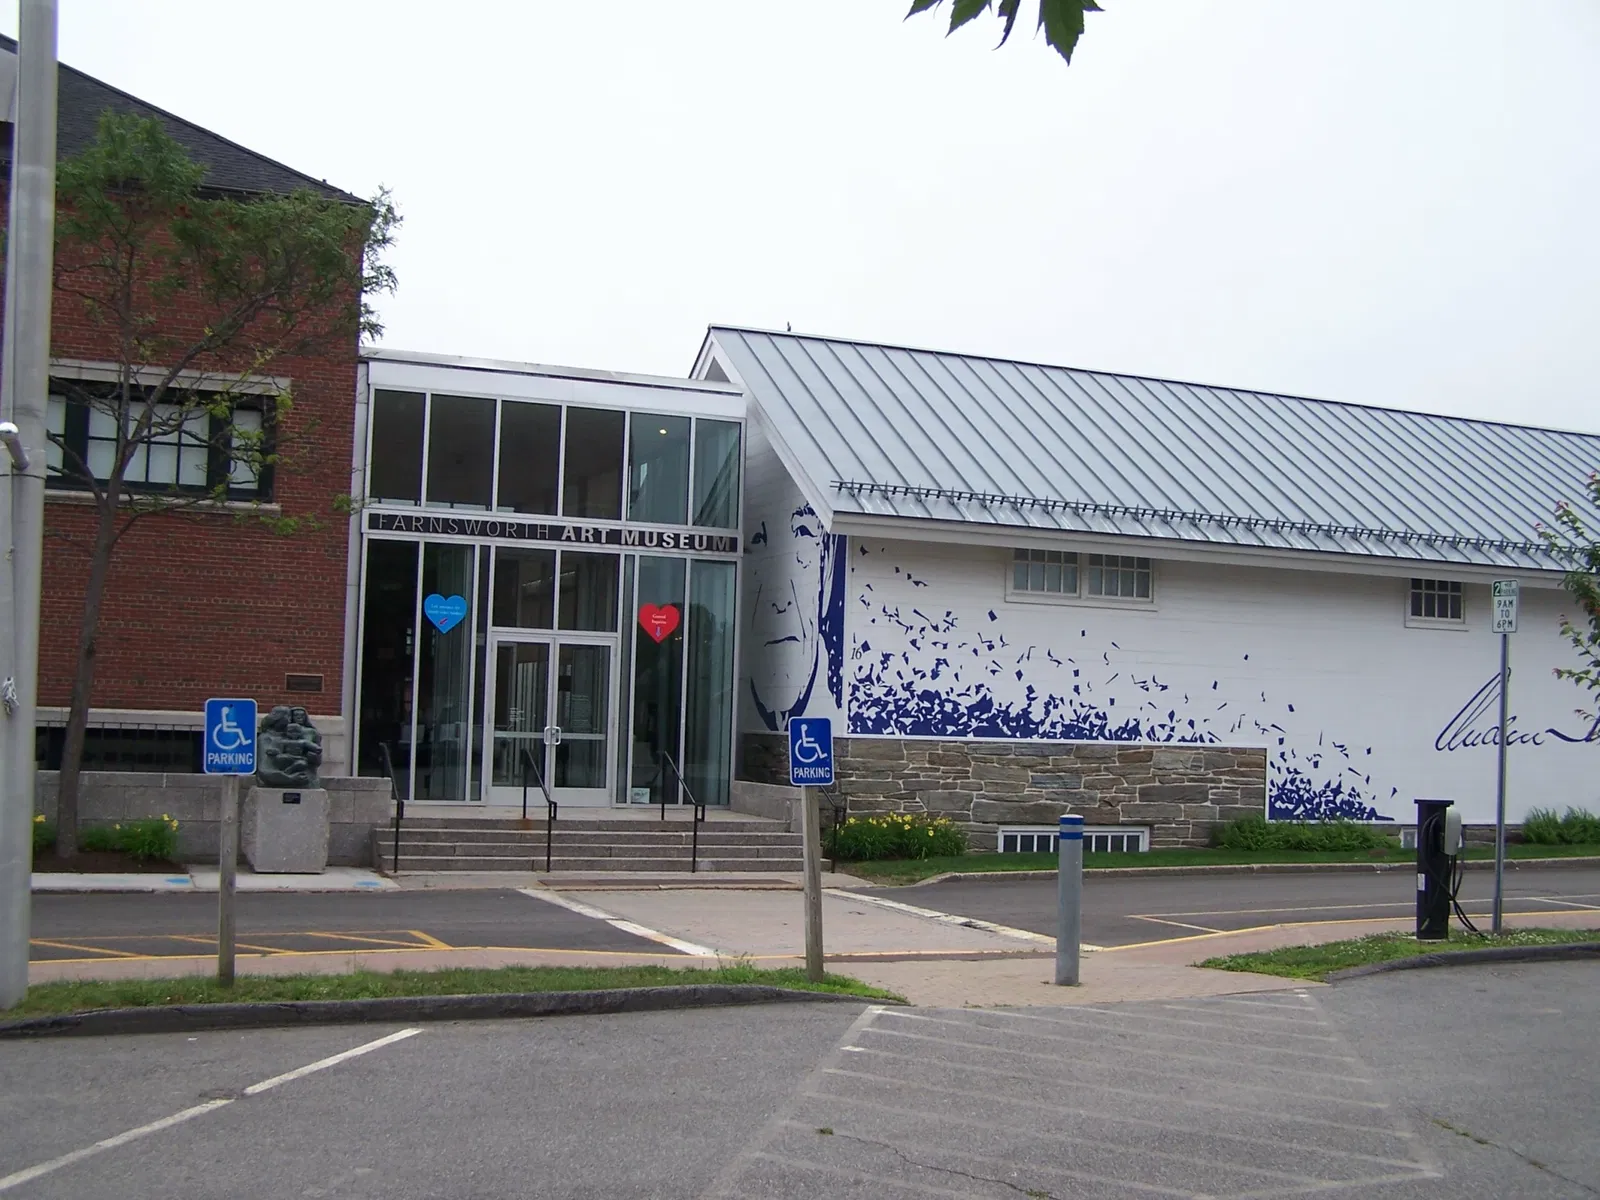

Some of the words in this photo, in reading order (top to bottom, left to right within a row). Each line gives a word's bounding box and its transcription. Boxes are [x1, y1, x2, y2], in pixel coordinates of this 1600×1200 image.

[379, 512, 549, 539] FARNSWORTH
[561, 525, 610, 543] ART
[621, 530, 729, 551] MUSEUM
[1494, 582, 1501, 596] 2
[1497, 599, 1514, 609] 9AM
[1501, 609, 1510, 619] TO
[1497, 620, 1513, 629] 6PM
[851, 647, 862, 660] 16
[207, 752, 253, 765] PARKING
[793, 767, 830, 779] PARKING
